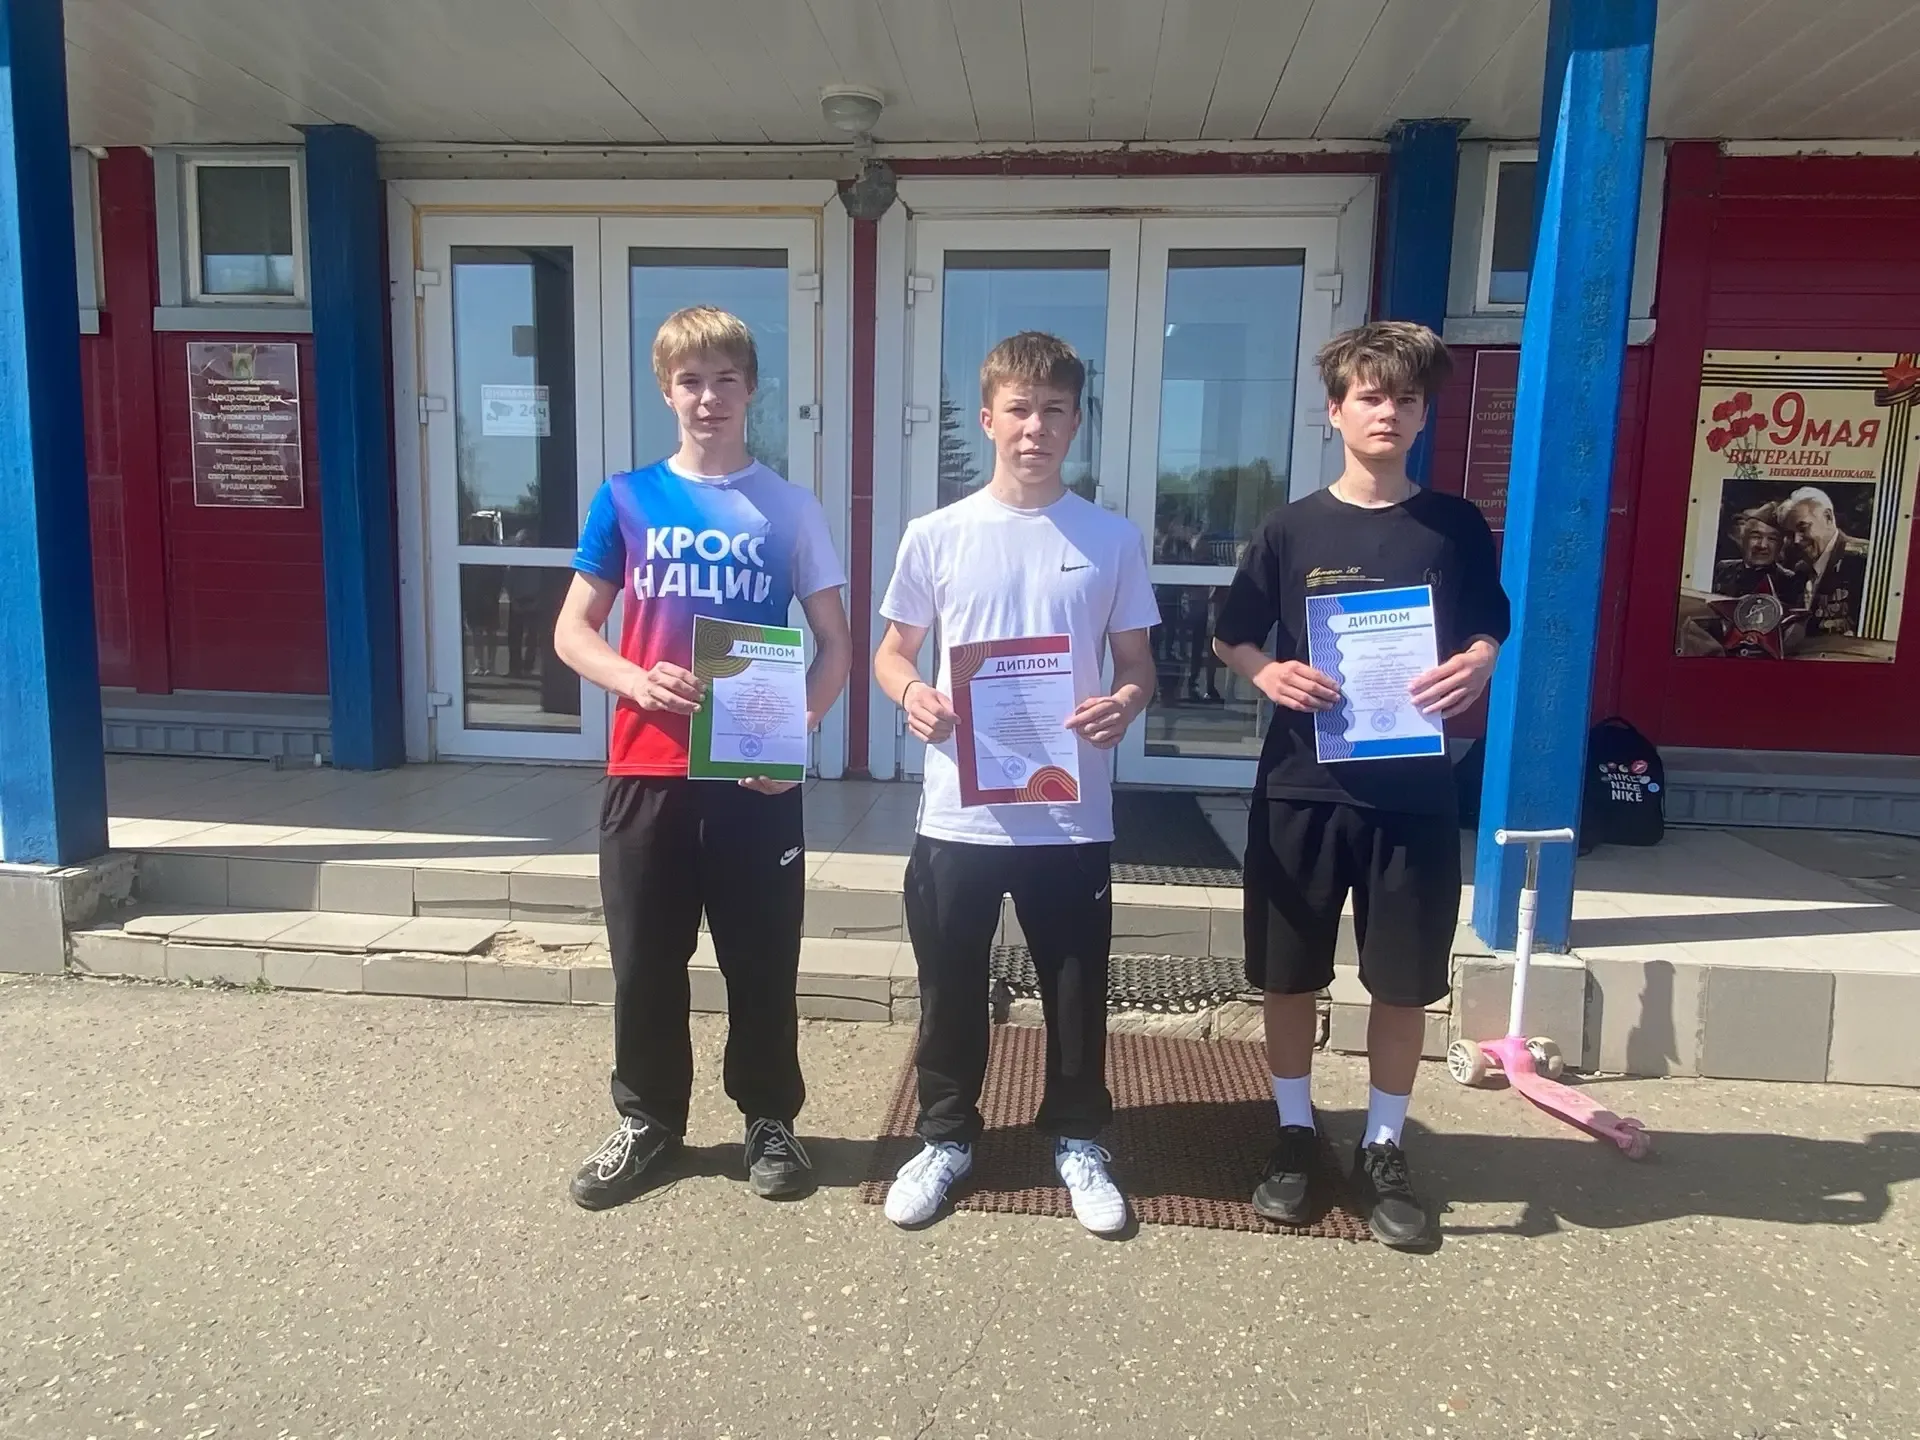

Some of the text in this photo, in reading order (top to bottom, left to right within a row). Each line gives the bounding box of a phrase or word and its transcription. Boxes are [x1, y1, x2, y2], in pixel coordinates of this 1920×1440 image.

[1769, 392, 1882, 448] 9 МАЯ
[1727, 449, 1832, 466] ВЕТЕРАНЫ
[1769, 467, 1812, 478] НИЗКИЙ
[1811, 468, 1834, 478] ВАМ
[646, 526, 766, 568] КРОСС
[633, 562, 774, 605] НАЦИИ
[1348, 611, 1411, 629] ДИПЛОМ
[740, 643, 796, 658] ДИПЛОМ
[995, 657, 1059, 673] ДИПЛОМ
[1611, 781, 1641, 792] NIKE
[1611, 790, 1643, 801] NIKE
